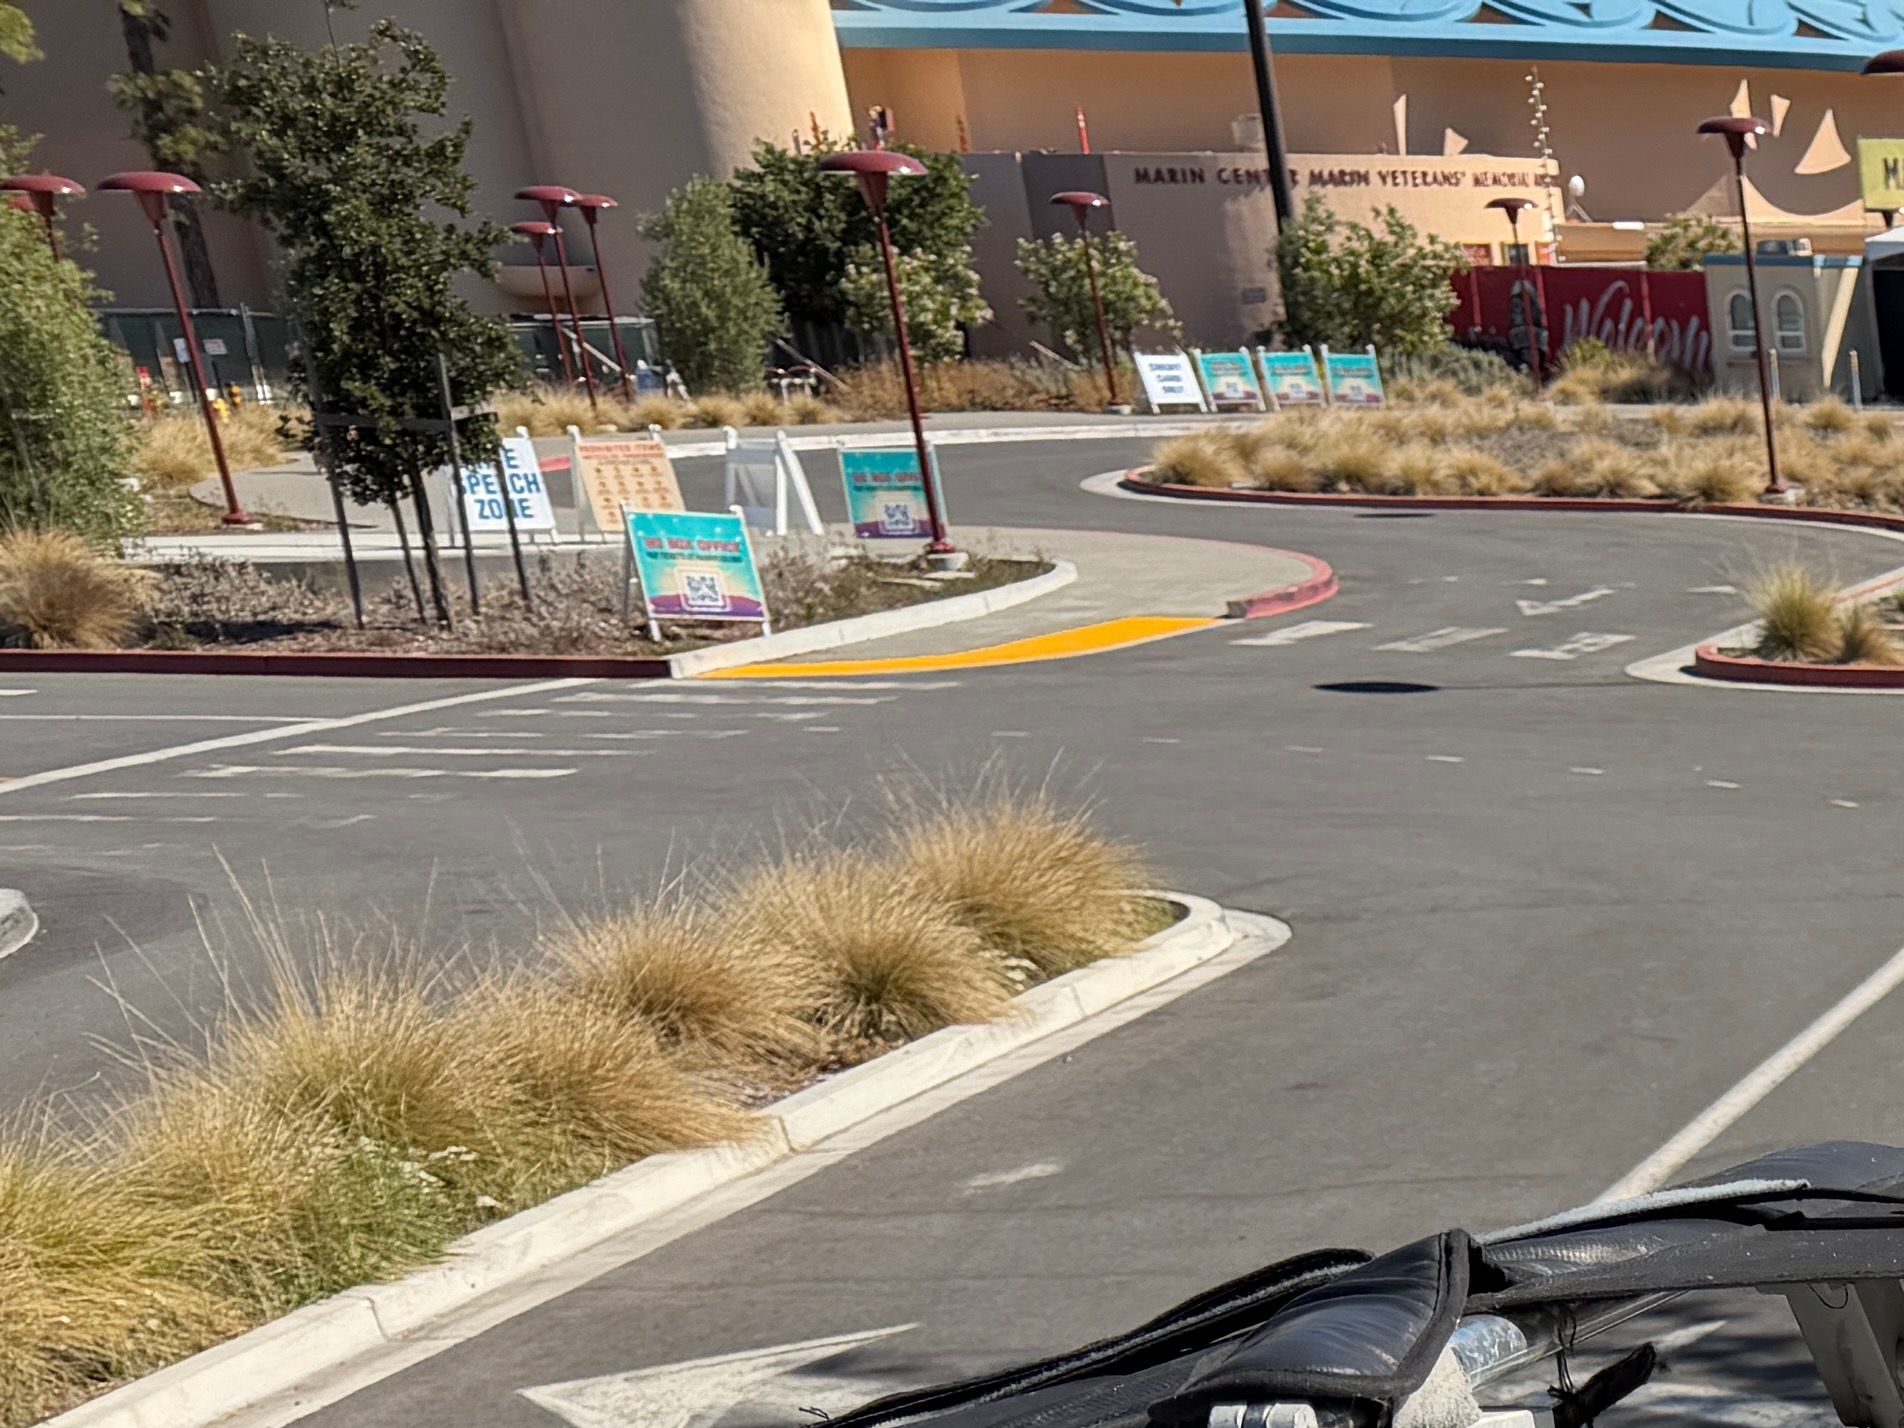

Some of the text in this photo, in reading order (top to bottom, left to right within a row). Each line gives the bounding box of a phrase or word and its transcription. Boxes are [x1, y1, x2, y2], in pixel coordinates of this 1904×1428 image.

[1134, 167, 1206, 185] MARIN
[1216, 168, 1299, 186] CENTR
[1308, 169, 1371, 188] MARIN
[460, 473, 542, 496] PECH
[478, 498, 534, 520] ZOE
